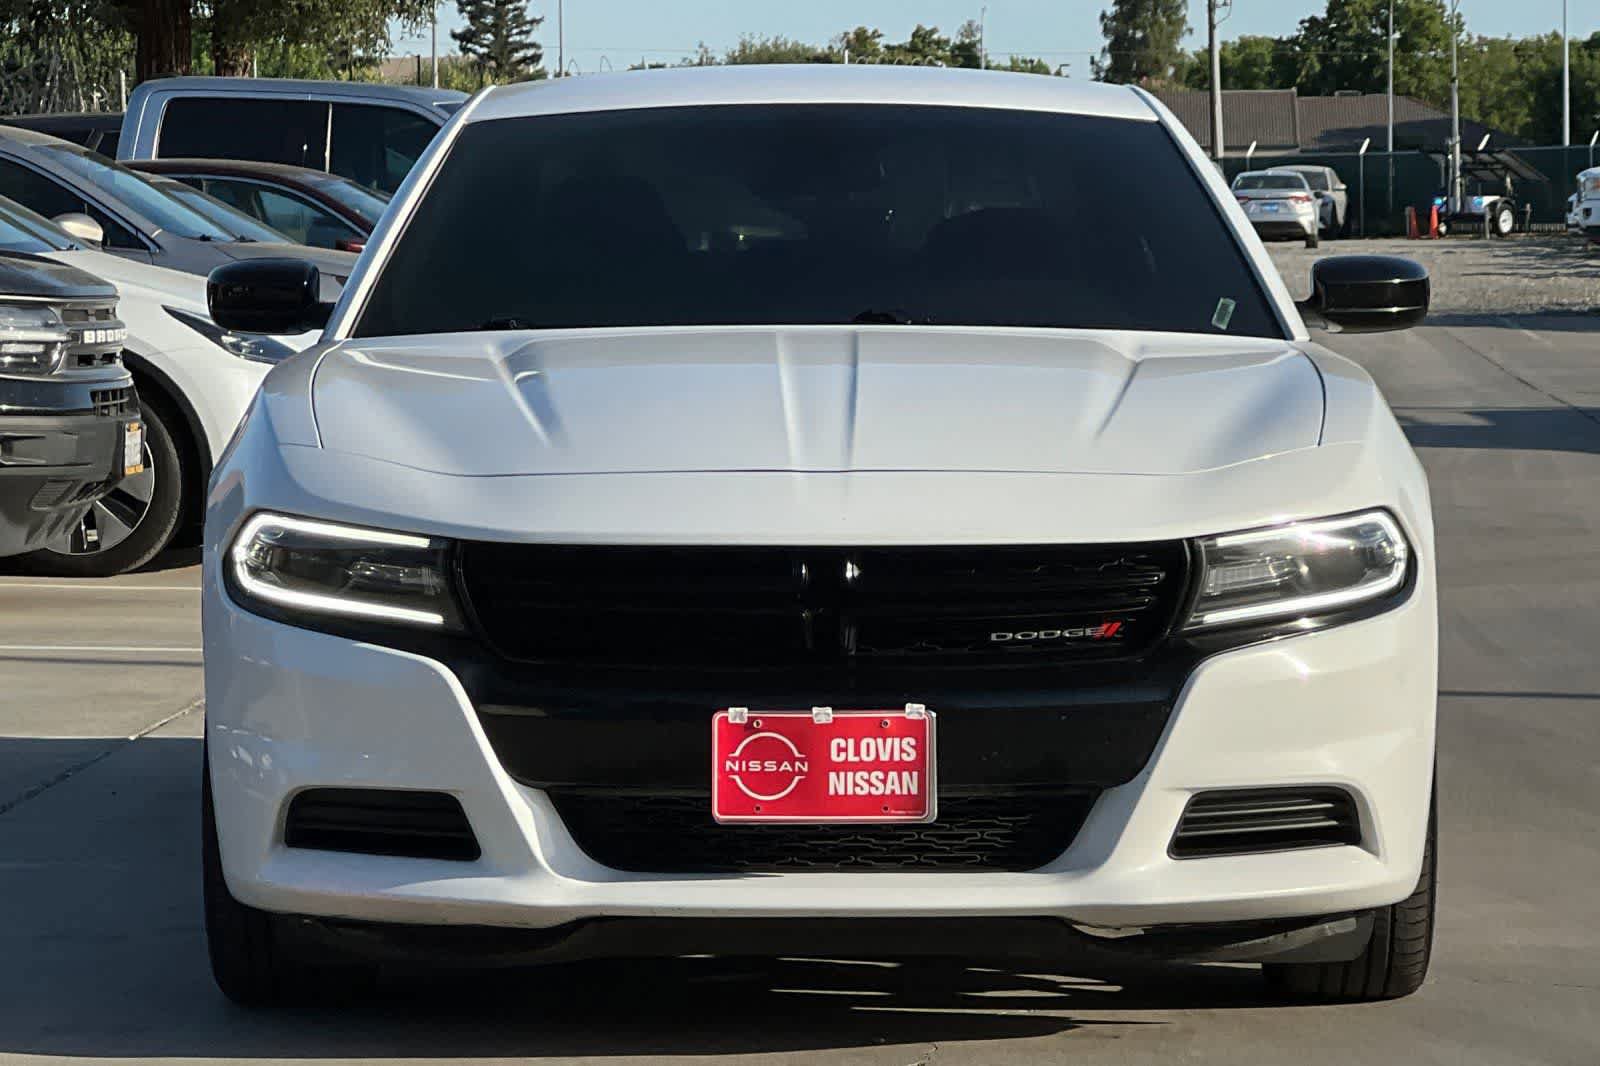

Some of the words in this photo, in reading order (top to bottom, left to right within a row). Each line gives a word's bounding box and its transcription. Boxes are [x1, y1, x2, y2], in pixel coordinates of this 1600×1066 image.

[991, 628, 1105, 641] DODGE
[830, 737, 917, 762] CLOVIS
[725, 760, 809, 772] NISSAN
[829, 771, 919, 796] NISSAN
